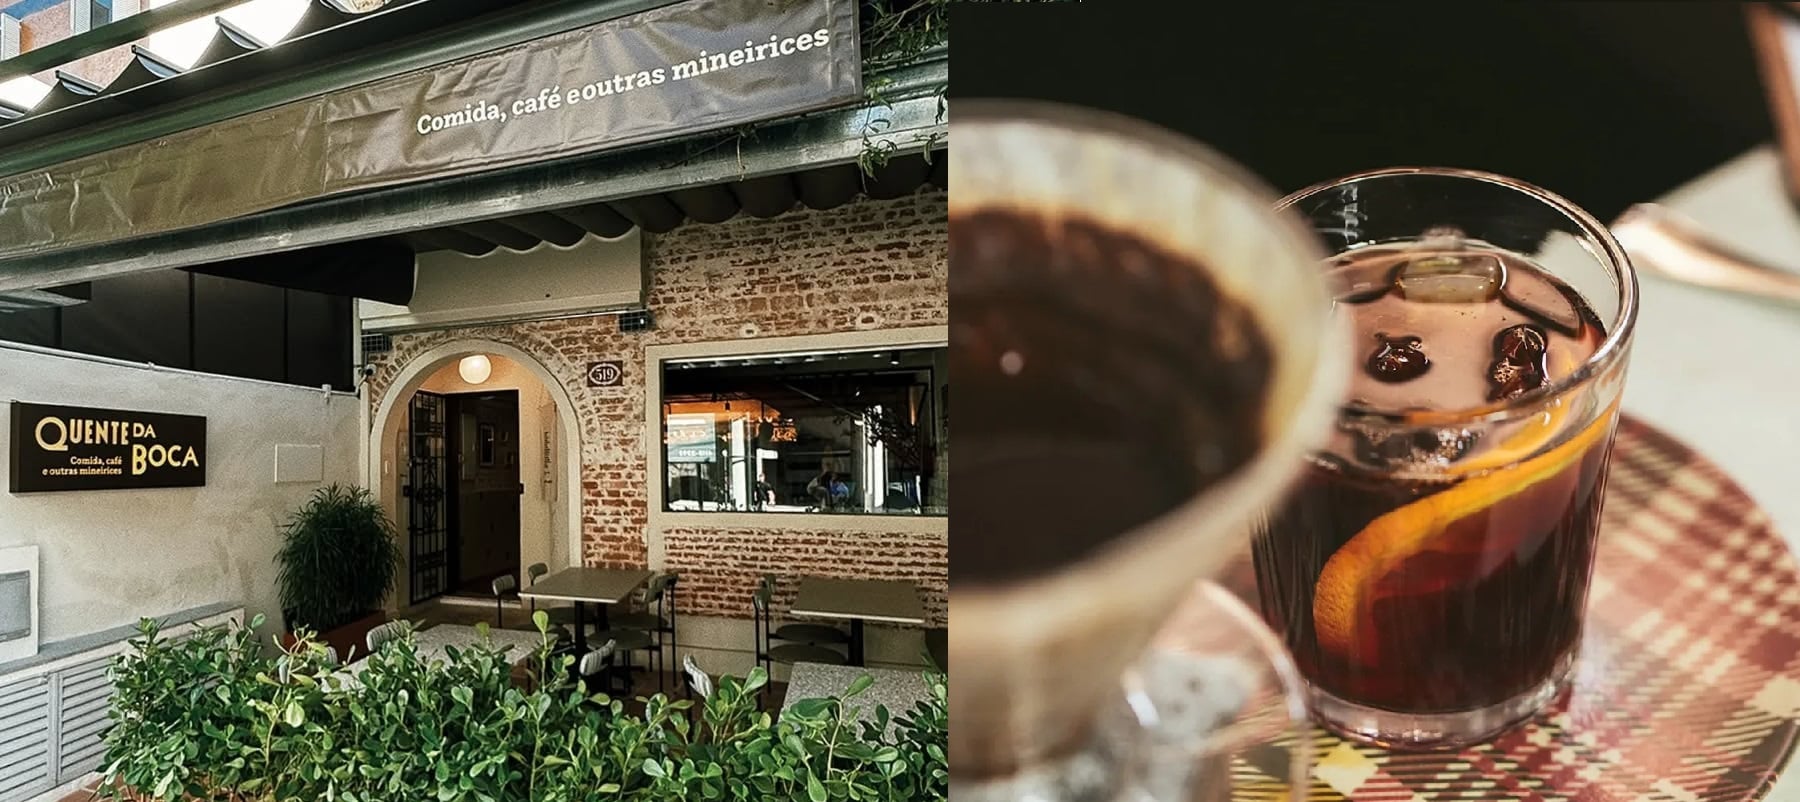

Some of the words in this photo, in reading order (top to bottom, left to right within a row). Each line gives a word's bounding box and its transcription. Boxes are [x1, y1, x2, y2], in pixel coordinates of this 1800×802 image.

[417, 100, 508, 135] Comida,
[511, 85, 562, 116] café
[671, 27, 830, 81] mineirices
[595, 368, 614, 381] 519
[35, 416, 130, 452] QUENTE
[132, 422, 157, 439] DA
[42, 468, 49, 476] e
[49, 467, 78, 476] outras
[79, 466, 123, 475] mineirices
[70, 455, 105, 466] Comida,
[105, 456, 122, 465] café
[131, 443, 200, 476] BOCA
